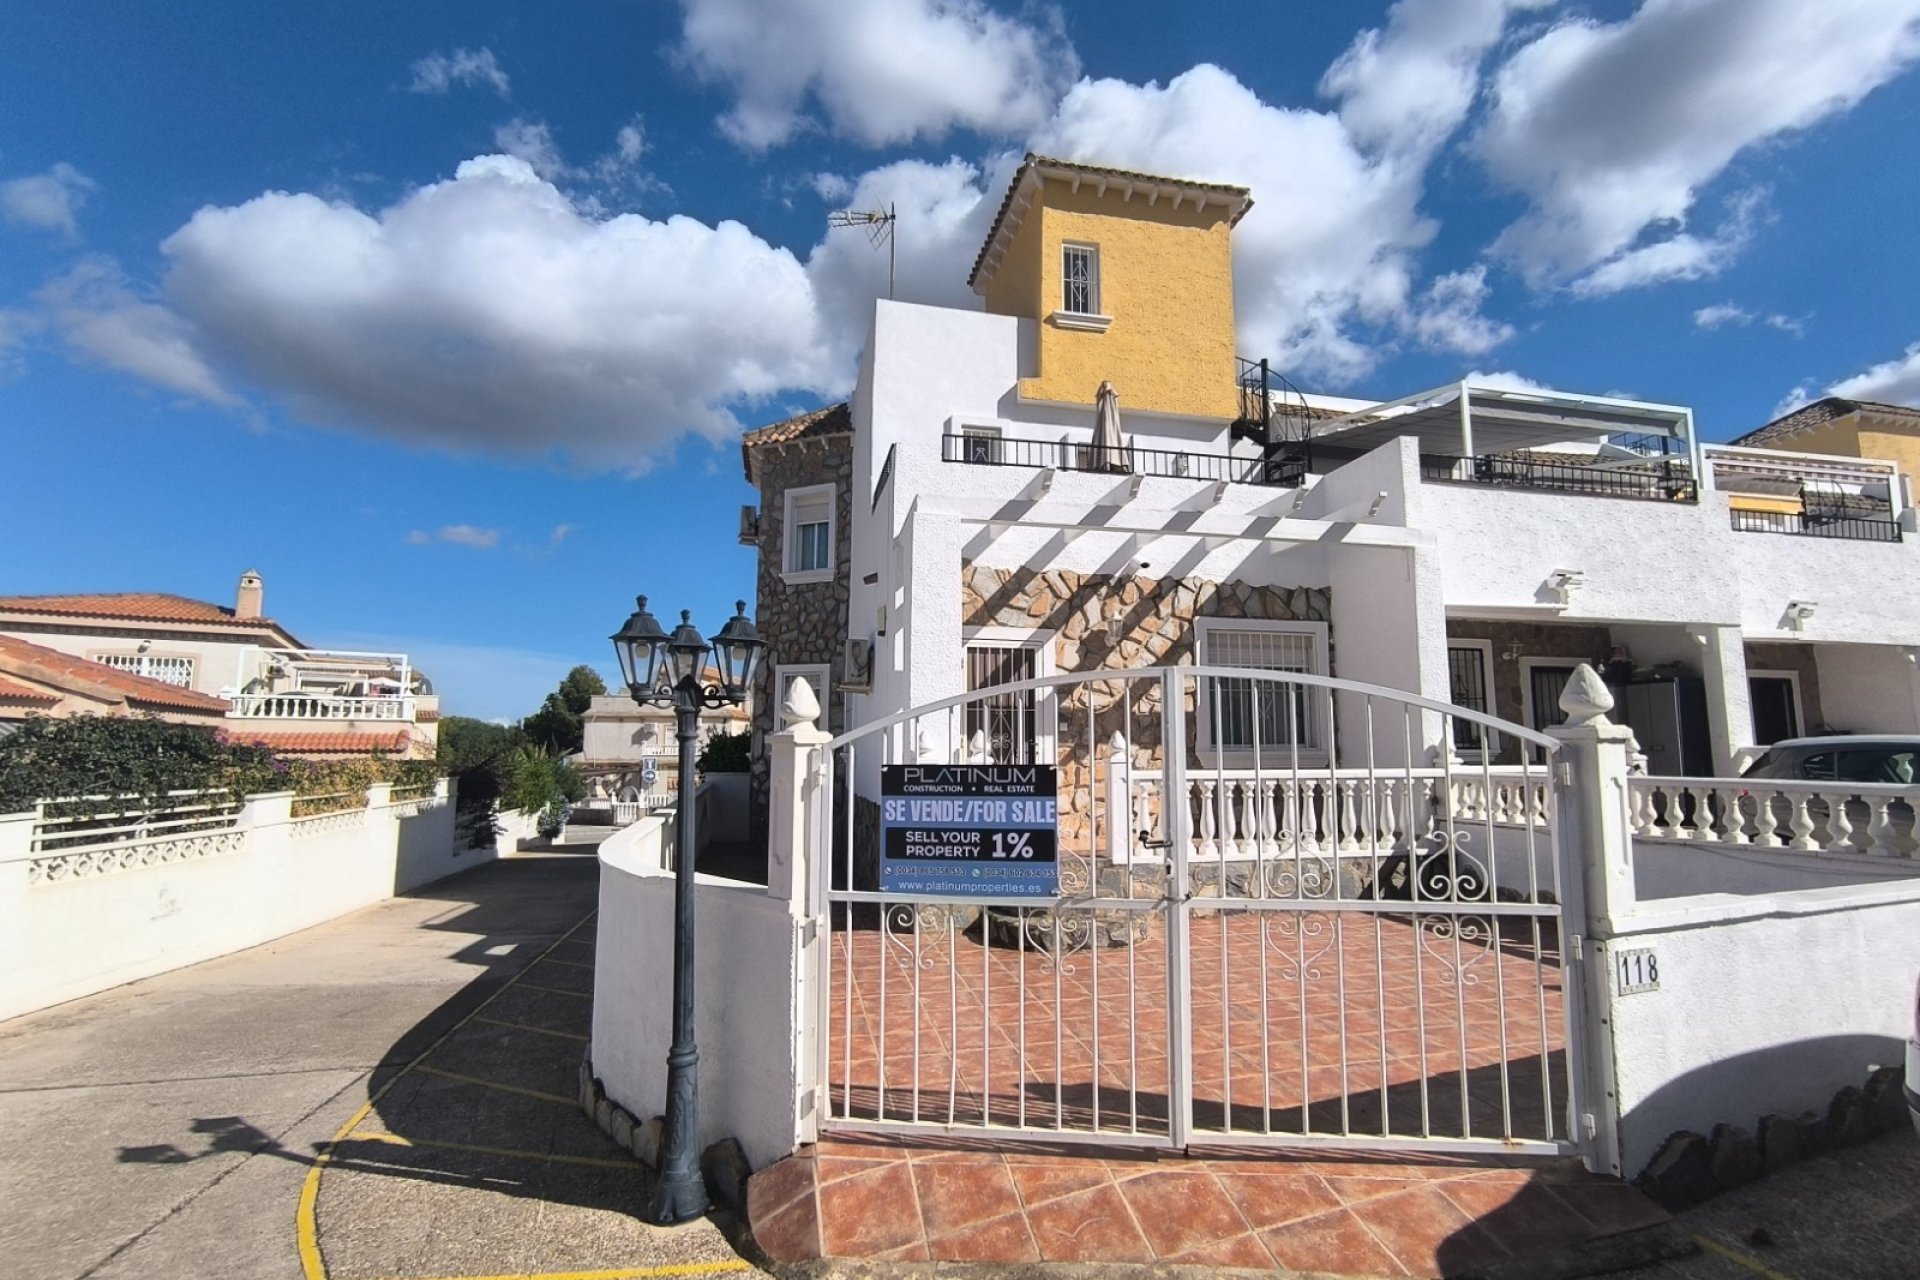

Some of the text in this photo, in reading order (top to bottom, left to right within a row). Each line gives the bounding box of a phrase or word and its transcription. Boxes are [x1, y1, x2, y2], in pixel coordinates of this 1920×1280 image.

[904, 768, 1036, 783] PLATINUM
[903, 785, 1035, 793] CONSTRUCTION REAL ESTATE
[885, 800, 1056, 823] SE VENDE/FOR SALE
[906, 832, 981, 844] SELL YOUR
[906, 845, 981, 857] PROPERTY
[992, 833, 1034, 858] 1%
[898, 881, 1041, 893] www.platinumproperties.es
[1621, 953, 1658, 986] 118
